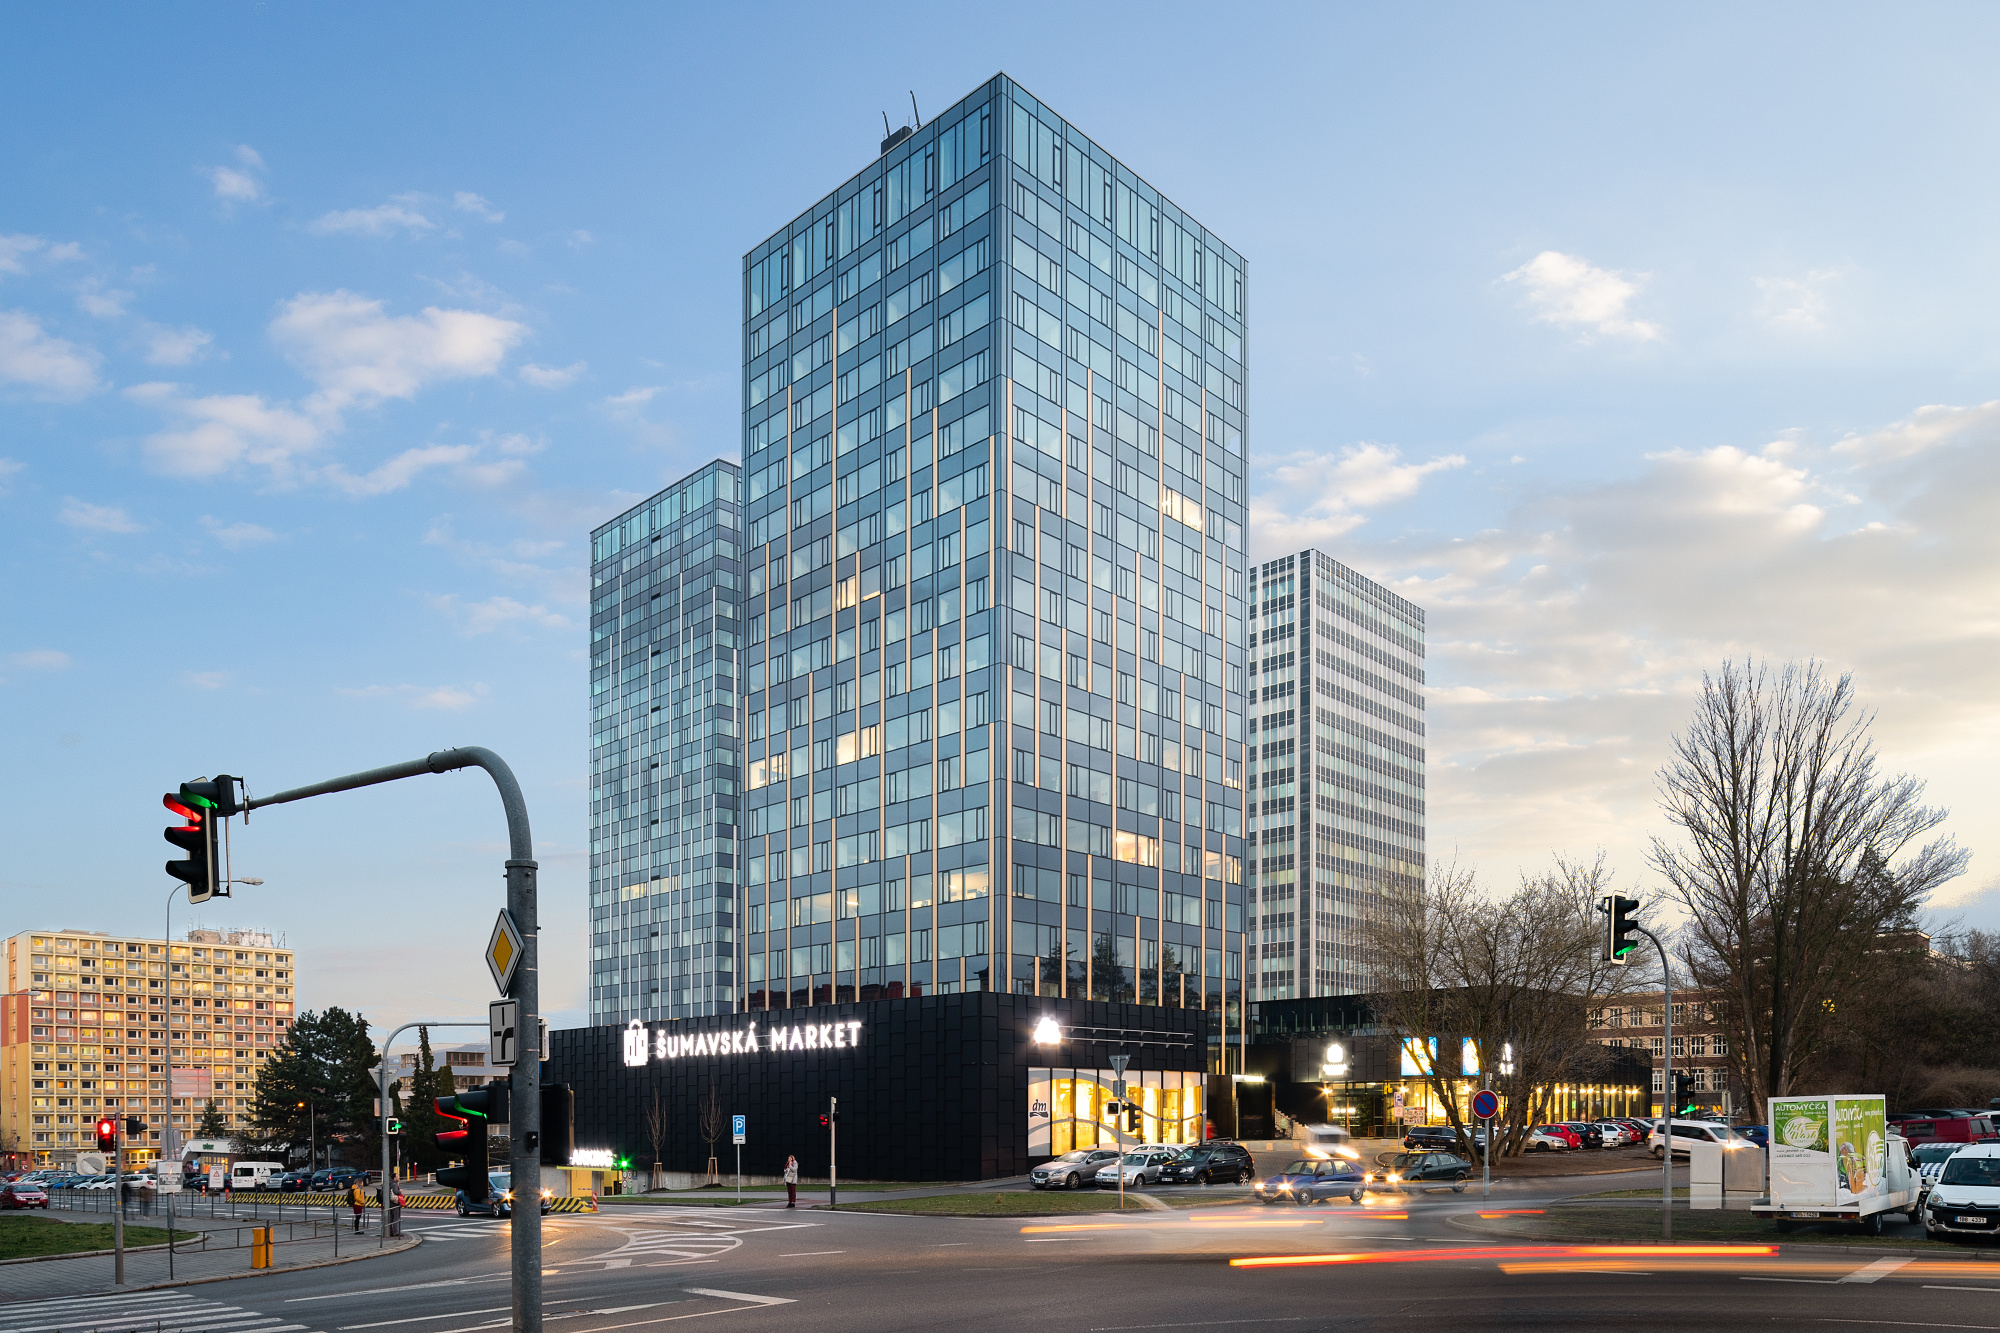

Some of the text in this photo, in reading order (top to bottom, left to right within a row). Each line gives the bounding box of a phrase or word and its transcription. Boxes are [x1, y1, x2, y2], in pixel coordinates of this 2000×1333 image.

[656, 1021, 862, 1059] ŠUMAVSKÁ MARKET
[1032, 1098, 1047, 1112] dm
[1775, 1102, 1827, 1112] AUTOMYČKA
[736, 1120, 743, 1132] P
